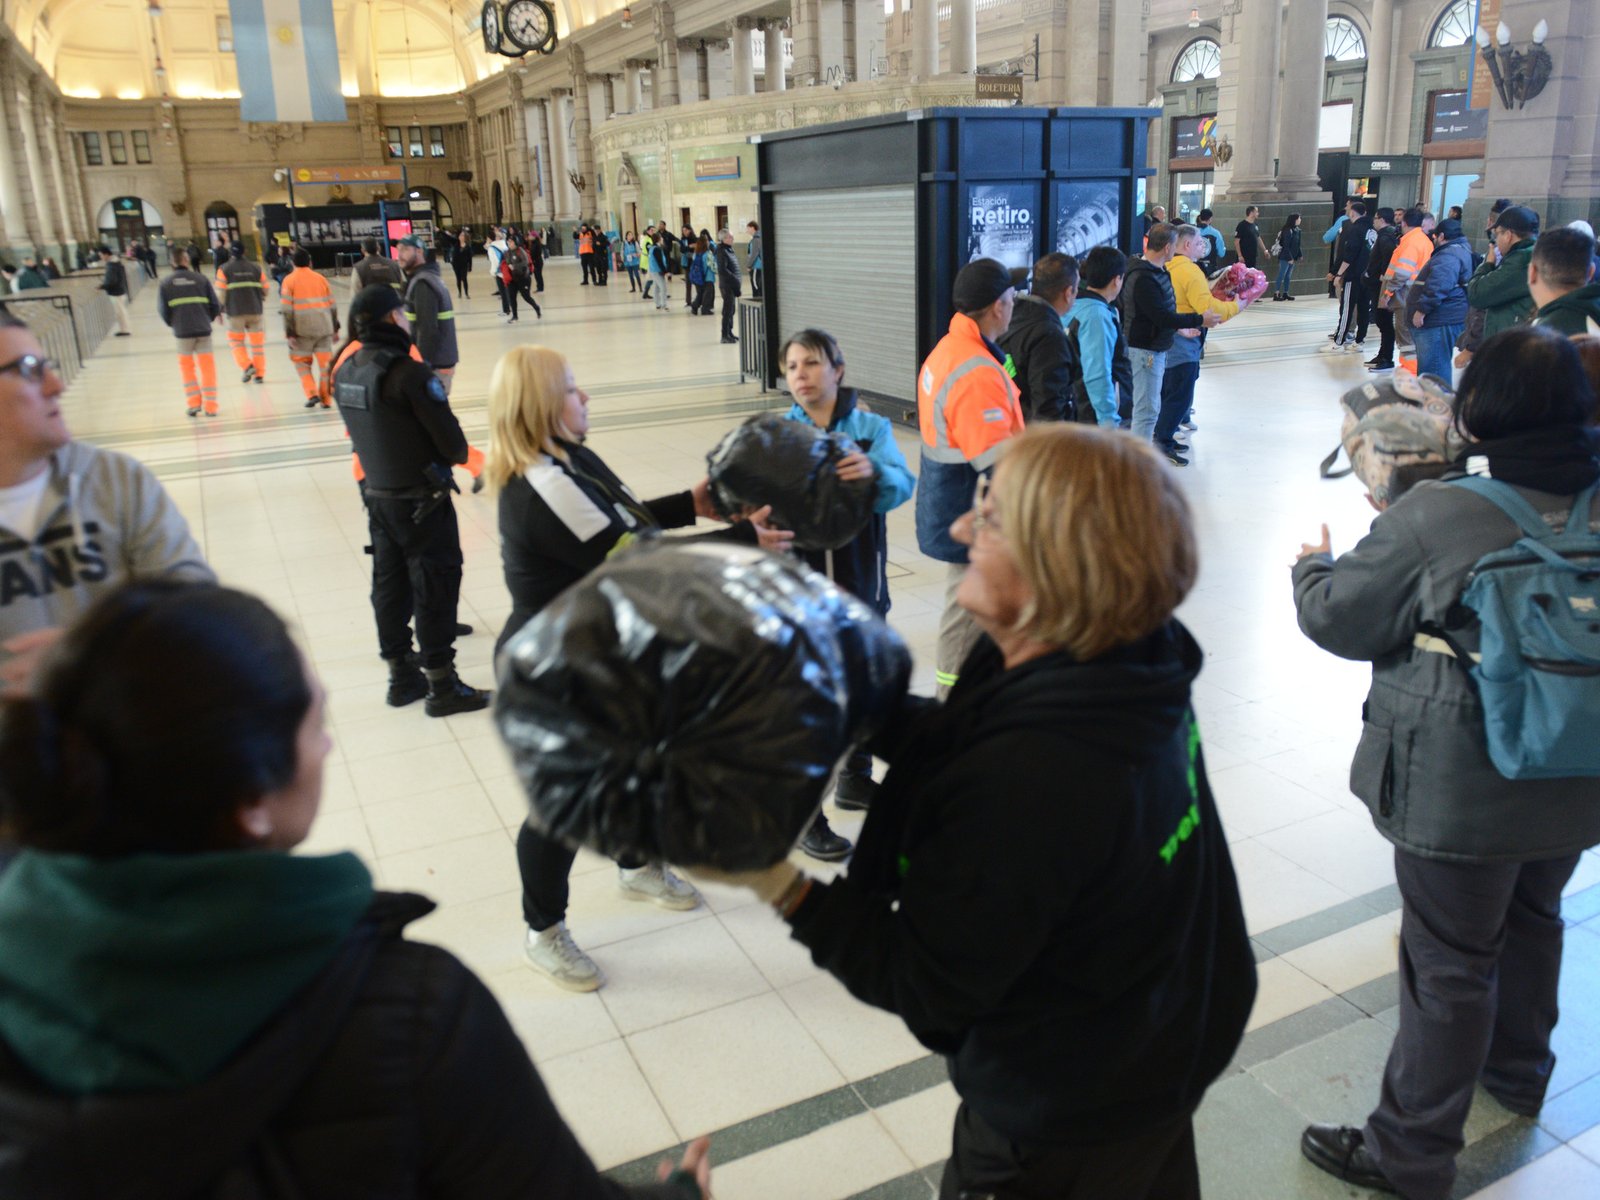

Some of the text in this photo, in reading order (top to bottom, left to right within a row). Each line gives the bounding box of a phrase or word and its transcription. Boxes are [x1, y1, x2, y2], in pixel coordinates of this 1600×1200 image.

[972, 196, 1007, 206] Estación
[972, 205, 1030, 225] Retiro
[0, 538, 108, 606] ANS
